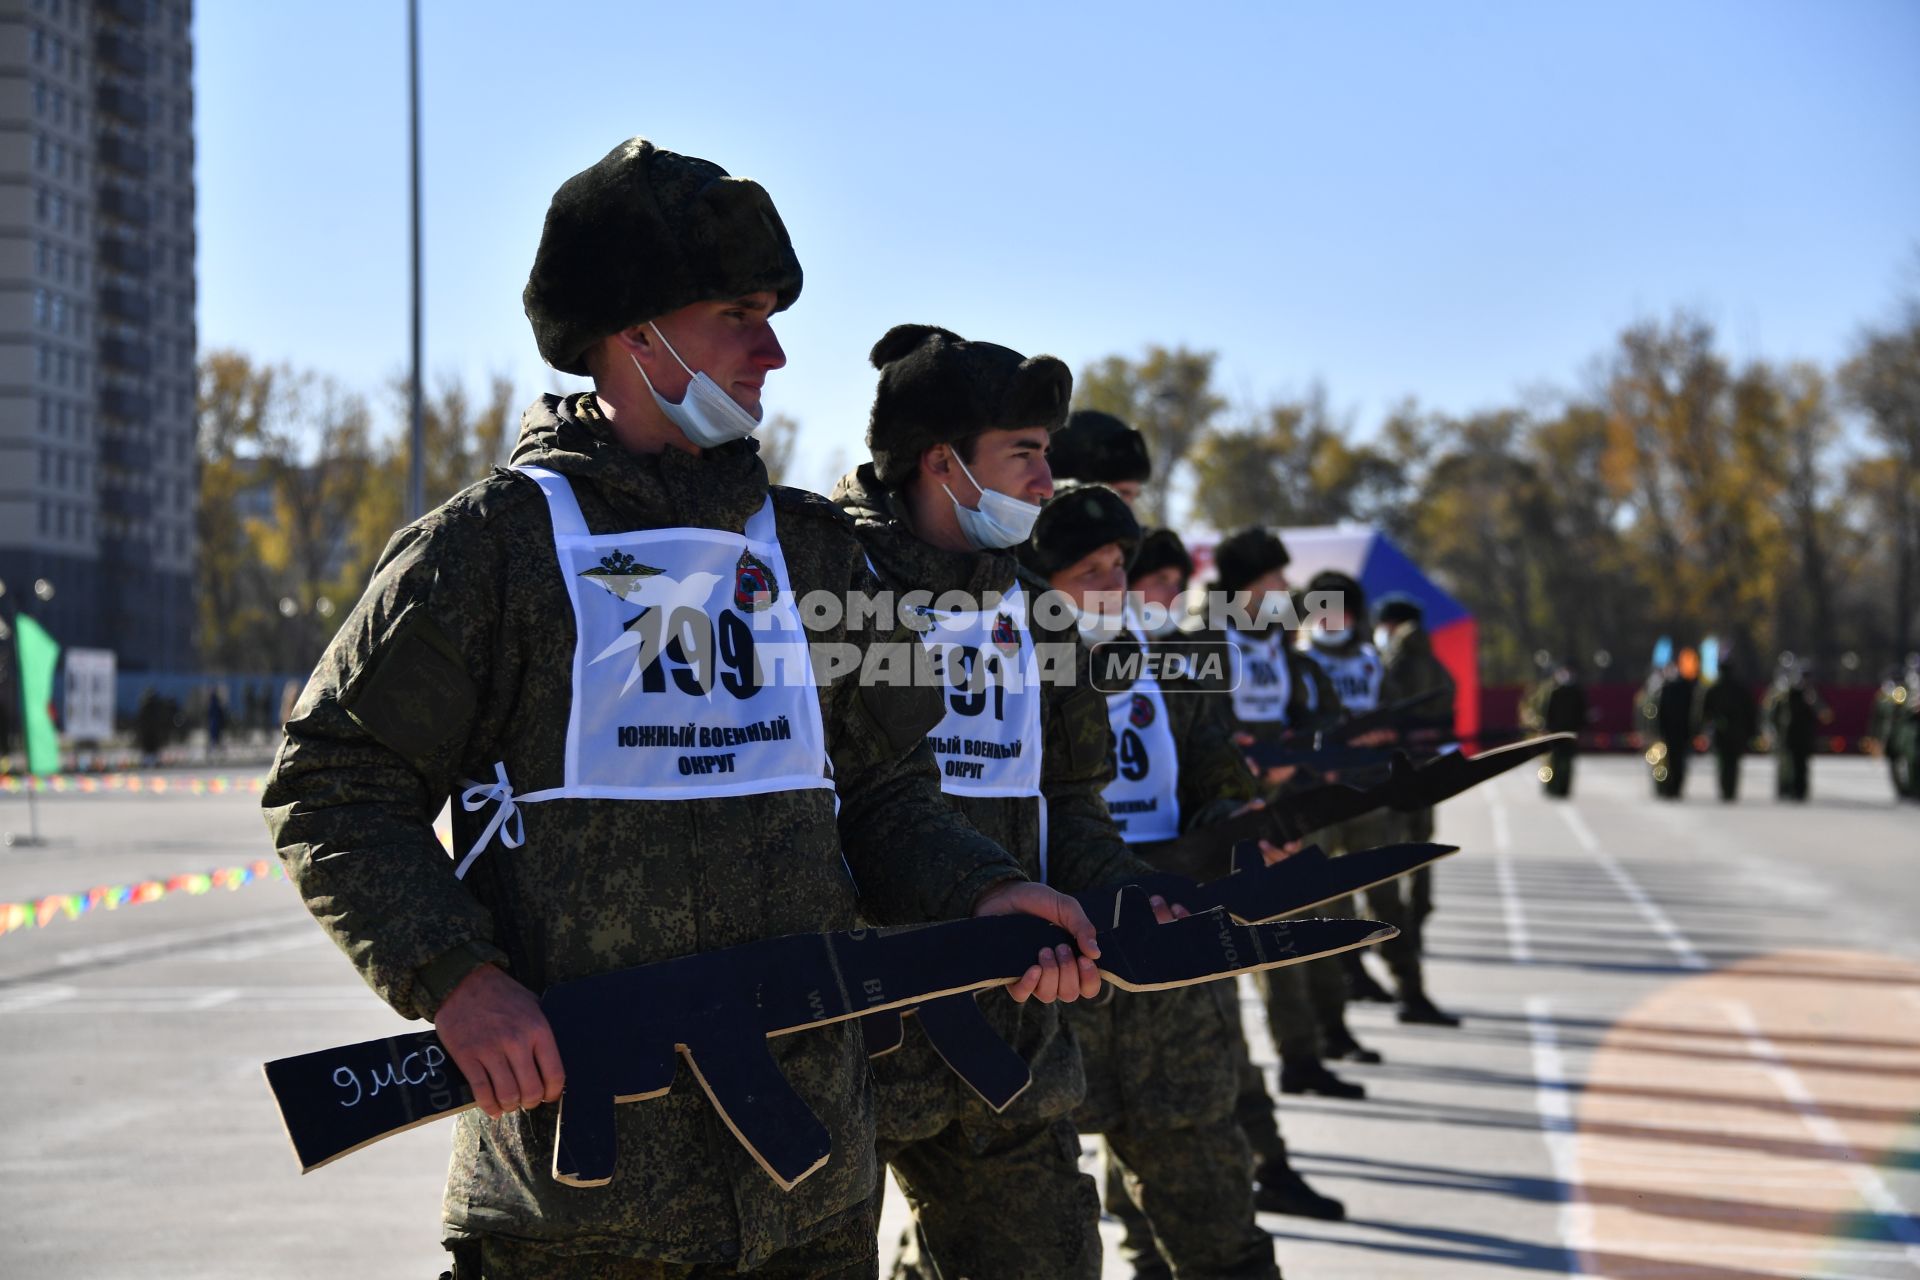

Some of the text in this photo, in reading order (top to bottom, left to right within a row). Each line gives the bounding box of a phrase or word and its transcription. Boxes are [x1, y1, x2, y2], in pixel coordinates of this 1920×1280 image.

[623, 605, 764, 700] 199
[618, 715, 791, 748] ЮЖНЫЙ ВОЕННЫЙ
[928, 736, 1022, 759] НЫЙ ВОЕННЫЙ
[678, 752, 736, 776] ОКРУГ
[945, 760, 984, 779] ОКРУГ
